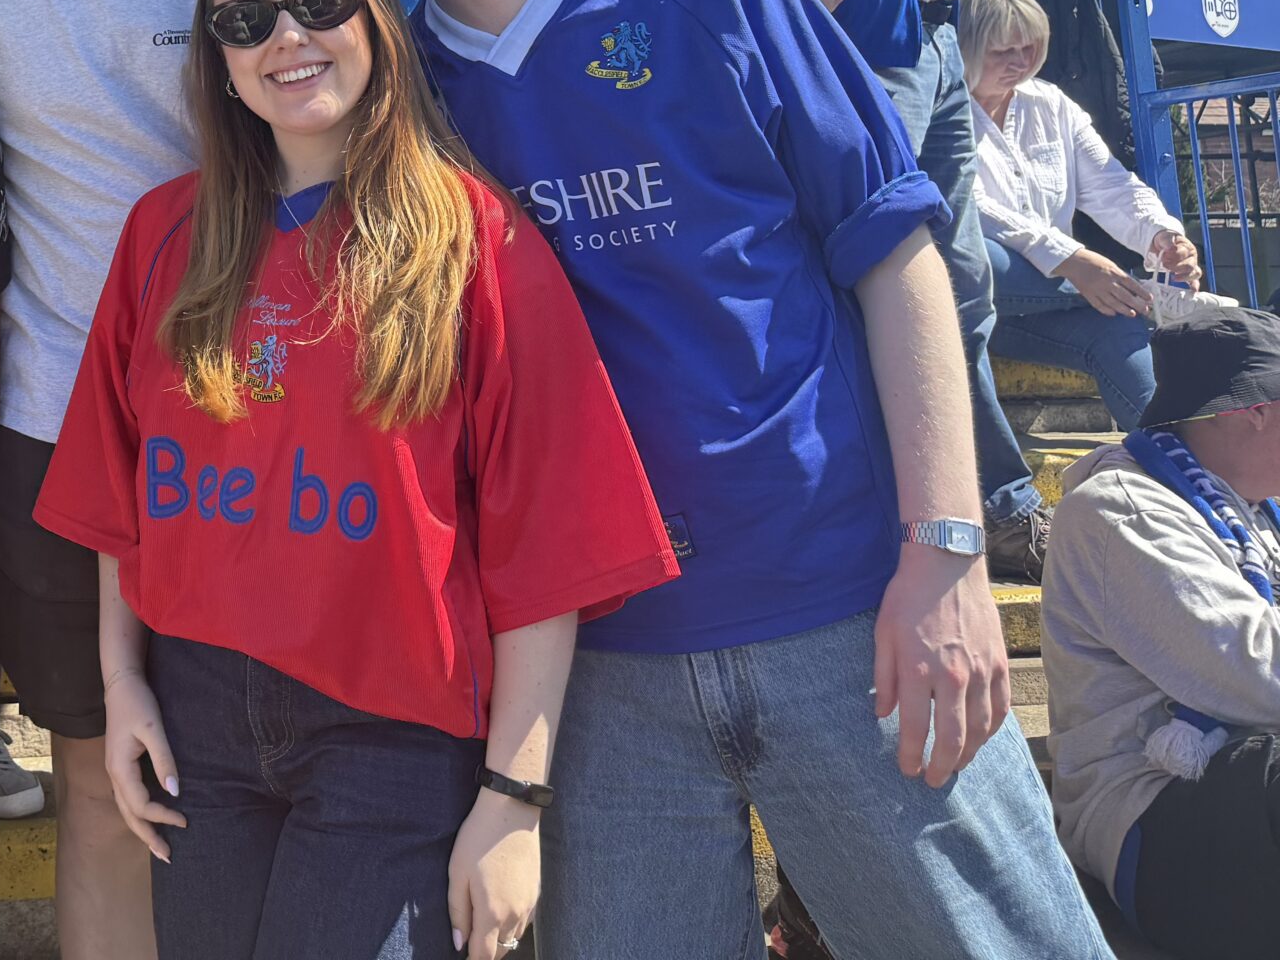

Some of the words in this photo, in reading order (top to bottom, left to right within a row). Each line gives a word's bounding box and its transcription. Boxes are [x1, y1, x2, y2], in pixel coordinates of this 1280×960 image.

[573, 220, 677, 251] SOCIETY
[253, 391, 273, 401] TOWN
[146, 435, 257, 524] Bee
[289, 446, 379, 541] bo
